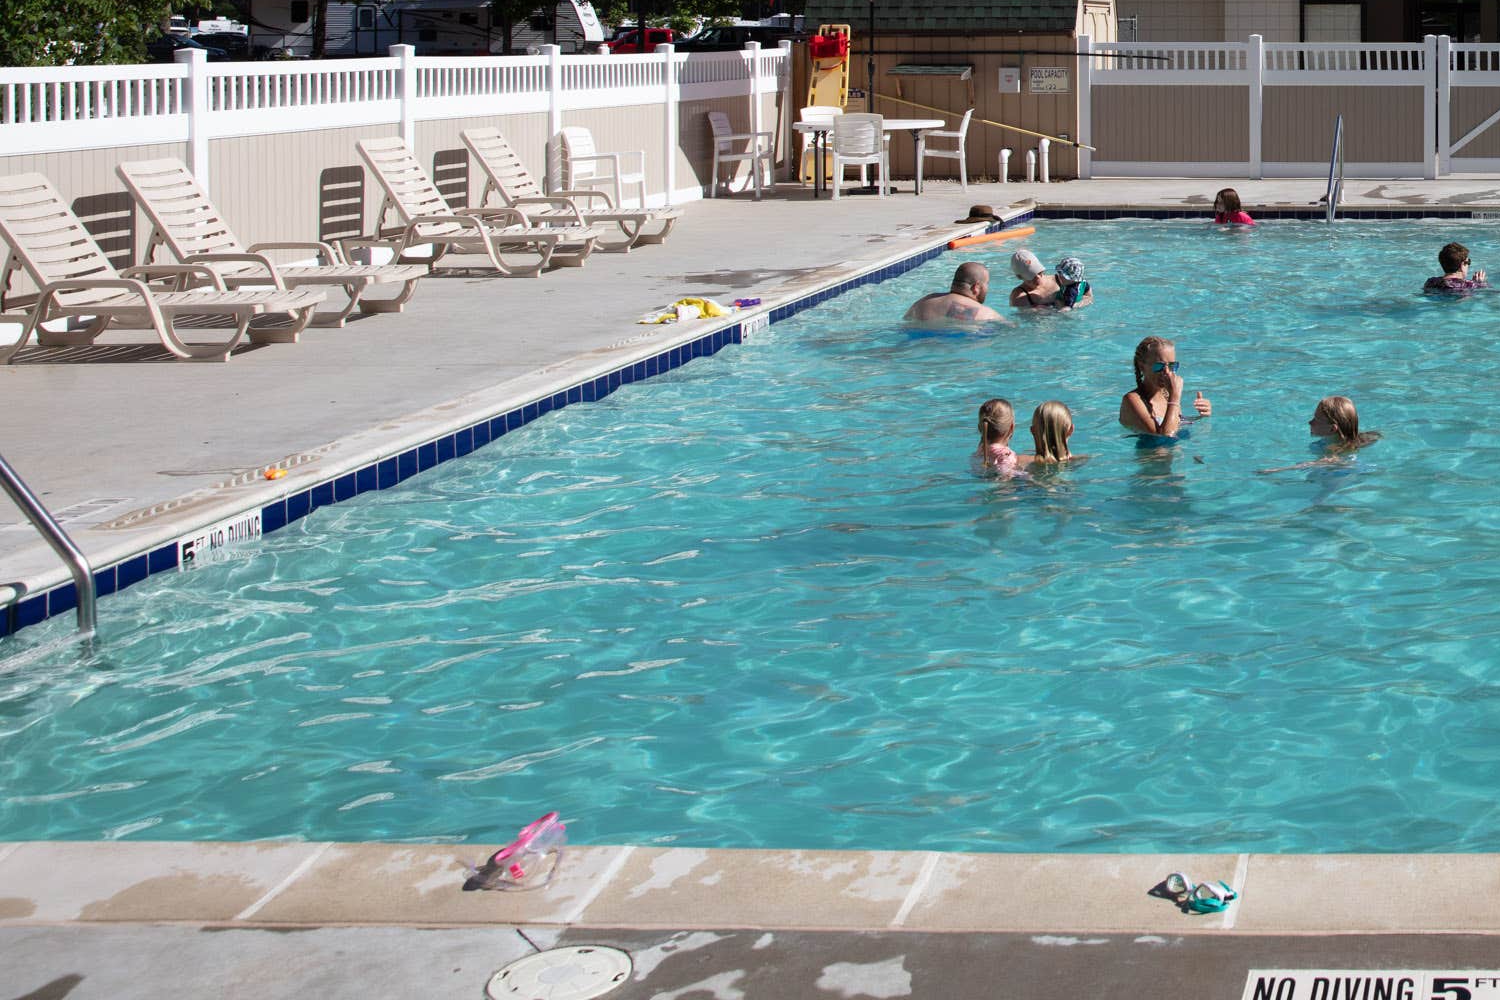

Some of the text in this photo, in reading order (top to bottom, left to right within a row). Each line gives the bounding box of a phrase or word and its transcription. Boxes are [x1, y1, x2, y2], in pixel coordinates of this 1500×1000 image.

[1031, 69, 1068, 79] POOL CAPACITY
[182, 541, 195, 563] 5
[210, 530, 224, 551] NO
[228, 515, 260, 543] DIVING
[1252, 977, 1297, 1000] NO
[1310, 977, 1415, 1000] DIVING
[1430, 978, 1472, 1000] 5
